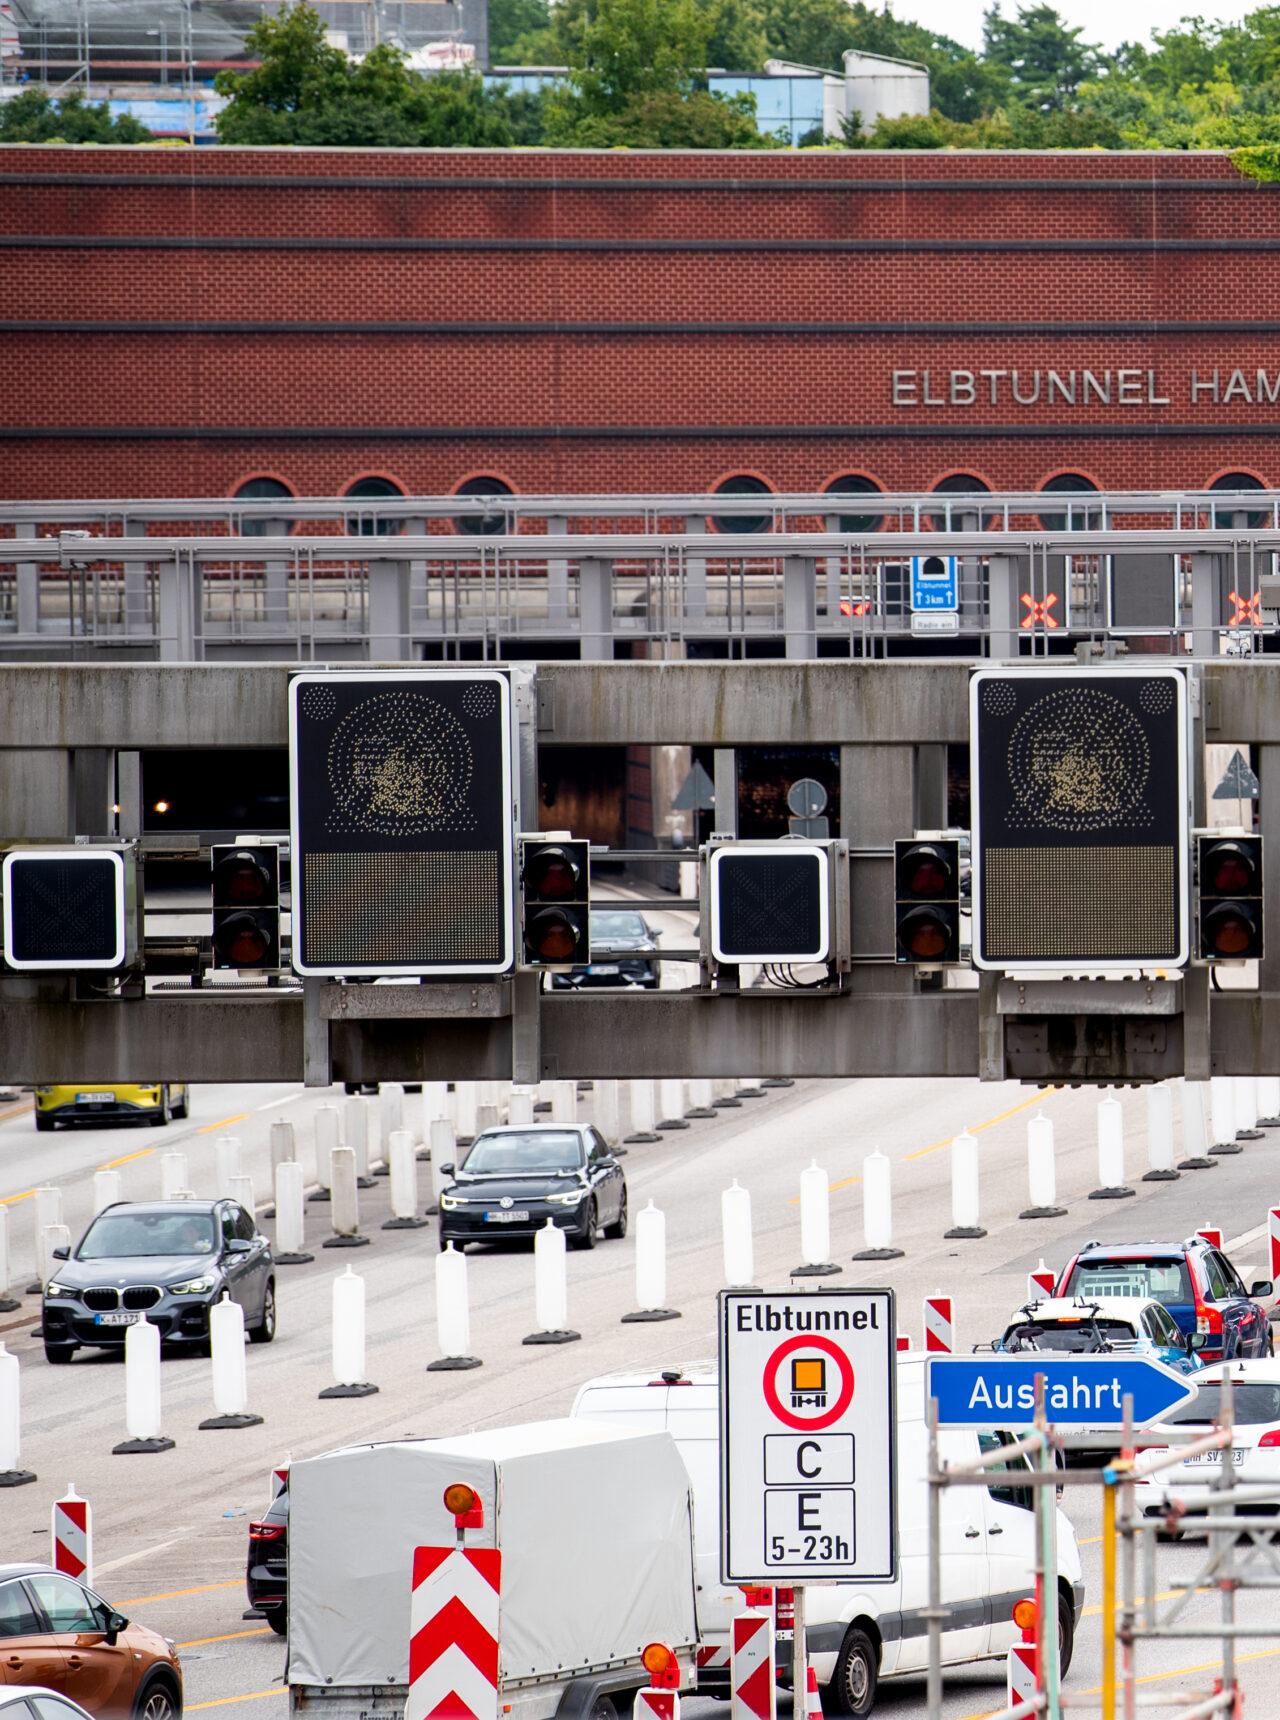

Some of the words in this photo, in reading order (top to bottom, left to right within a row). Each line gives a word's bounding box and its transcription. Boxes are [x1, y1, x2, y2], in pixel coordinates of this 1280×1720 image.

[892, 369, 1171, 405] ELBTUNNEL
[925, 594, 930, 605] 3
[931, 594, 944, 605] km
[736, 1302, 879, 1332] Elbtunnel
[968, 1375, 1122, 1409] Ausahrt
[796, 1440, 823, 1479] C
[798, 1492, 822, 1532] E
[771, 1535, 850, 1561] 5-23h
